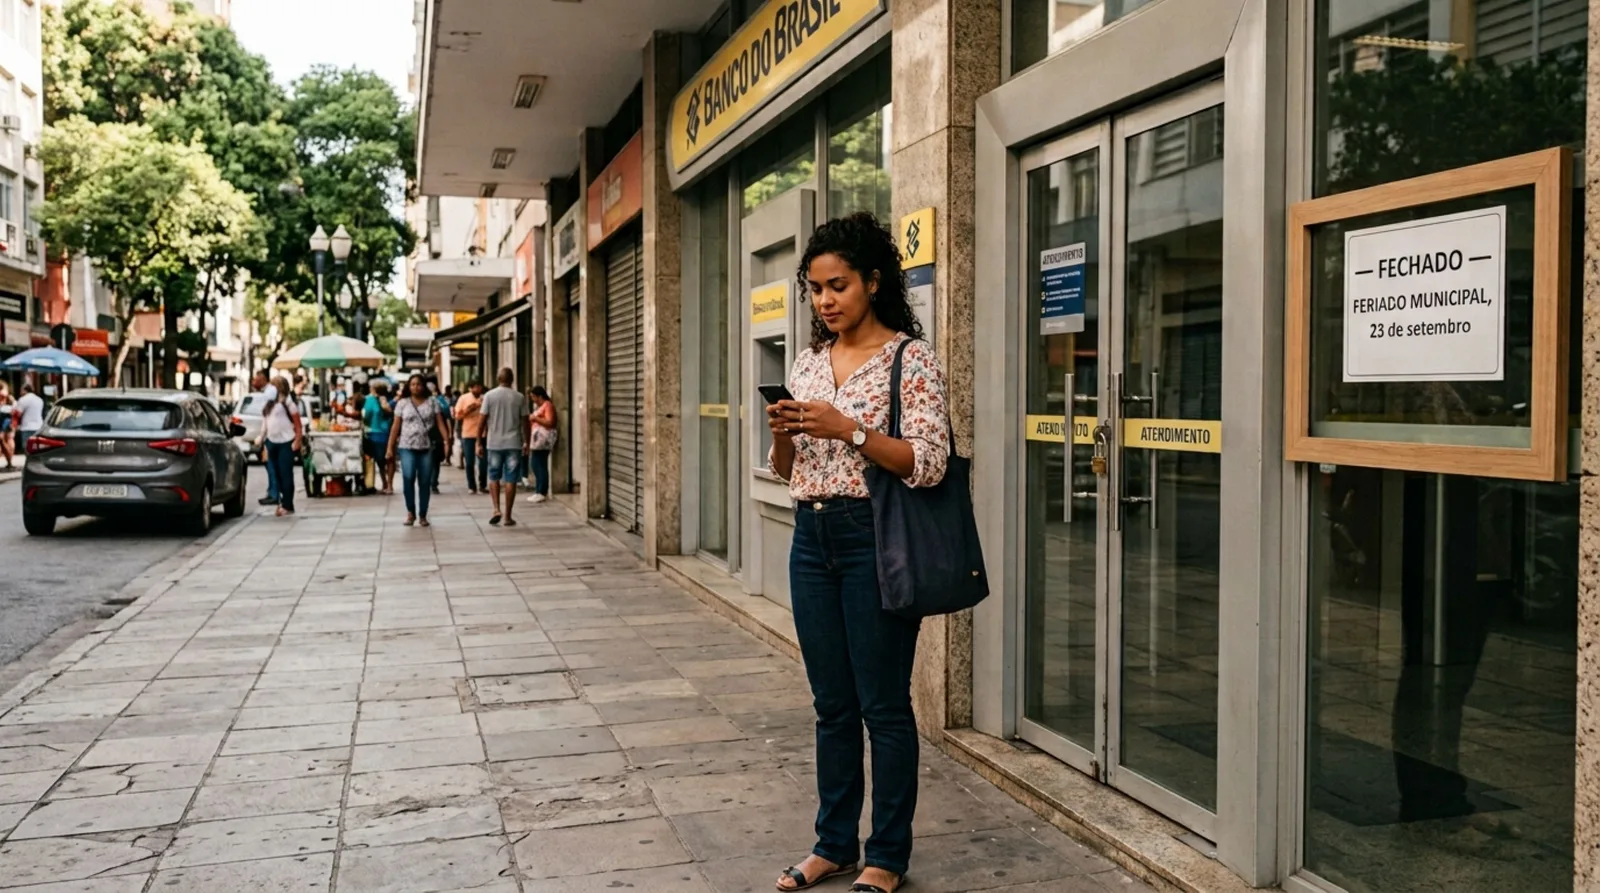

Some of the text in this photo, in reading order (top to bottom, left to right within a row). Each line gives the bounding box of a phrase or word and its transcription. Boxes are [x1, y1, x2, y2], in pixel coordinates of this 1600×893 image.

[703, 48, 748, 127] BANCO
[751, 28, 771, 87] DO
[1378, 249, 1463, 279] FECHADO
[1353, 288, 1492, 314] FERIADO MUNICIPAL,
[1369, 318, 1471, 339] 23 de setembro
